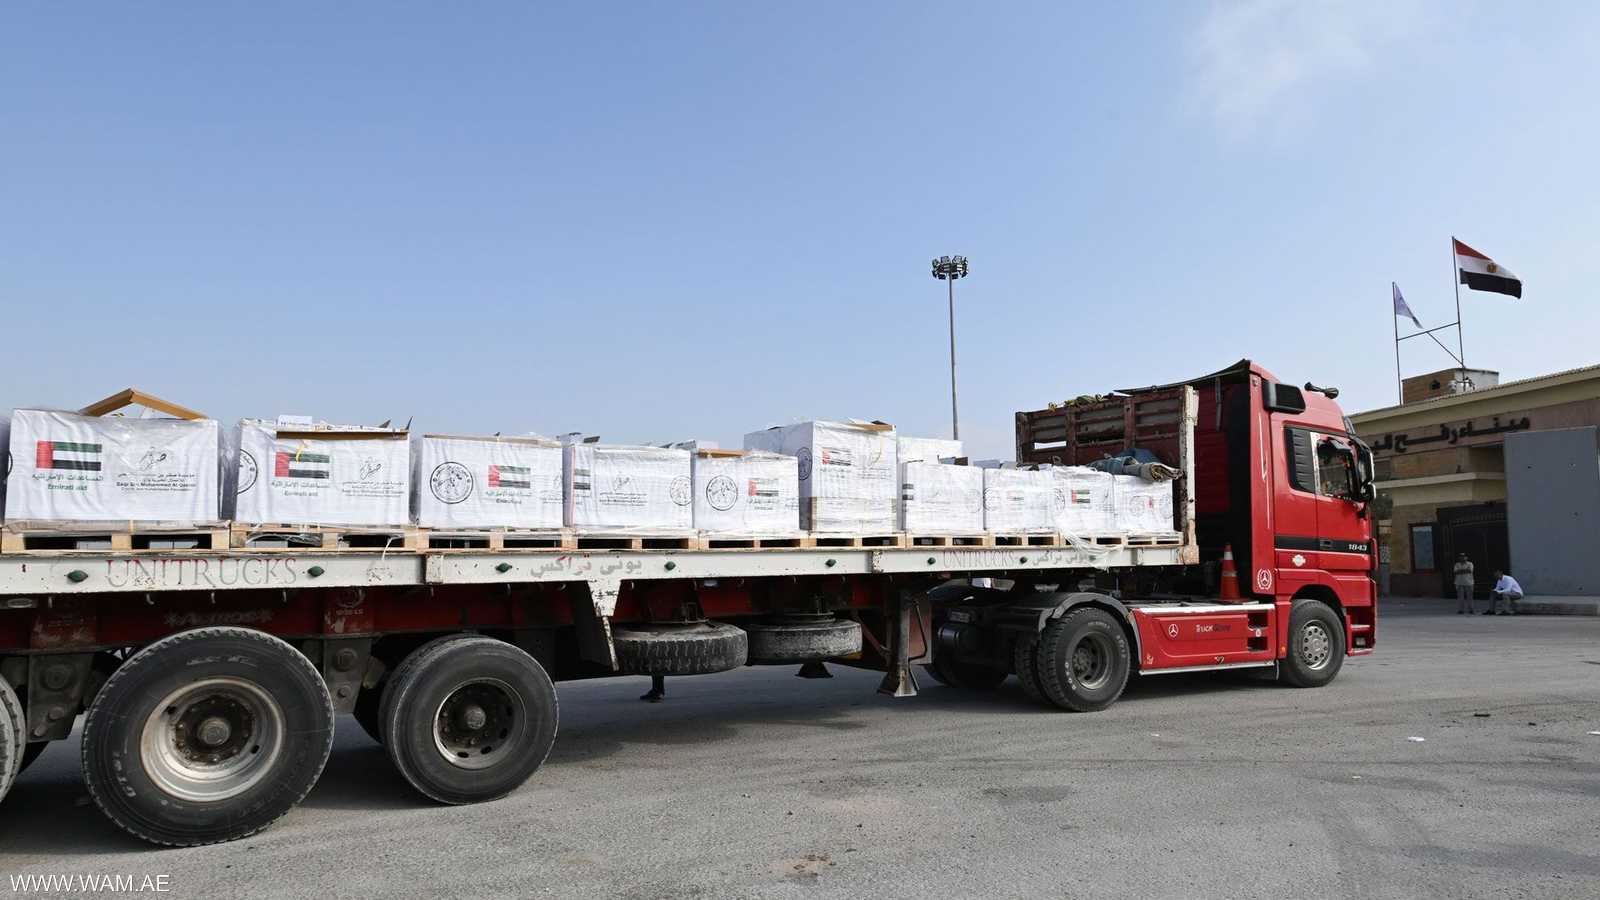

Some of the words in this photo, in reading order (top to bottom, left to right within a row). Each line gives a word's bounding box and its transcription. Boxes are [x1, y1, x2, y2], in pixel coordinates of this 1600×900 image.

[1458, 416, 1531, 437] ميناء
[1371, 433, 1393, 455] الب
[1394, 423, 1459, 453] رفح
[48, 483, 74, 492] Emirati
[1348, 543, 1368, 551] 1843
[943, 550, 1015, 568] UNITRUCKS
[105, 557, 297, 588] UNITRUCKS
